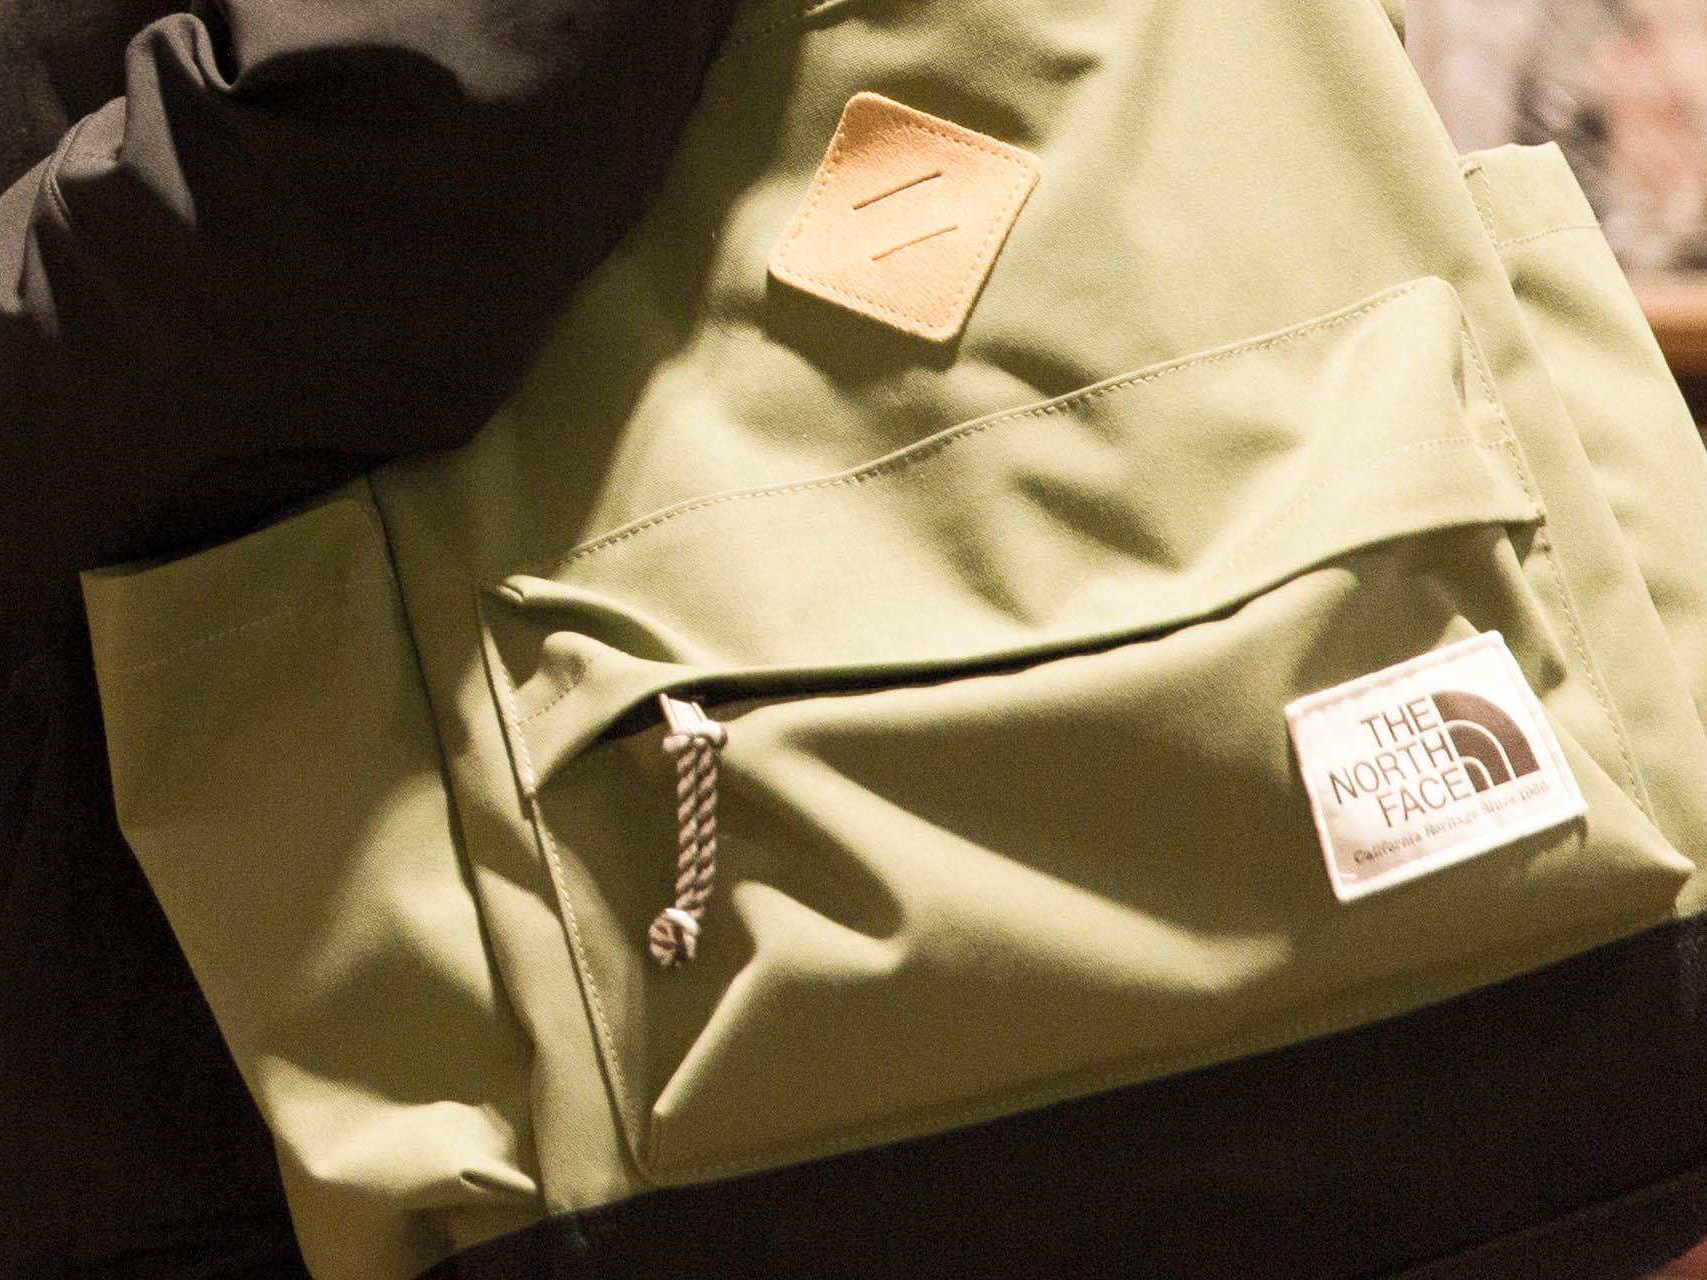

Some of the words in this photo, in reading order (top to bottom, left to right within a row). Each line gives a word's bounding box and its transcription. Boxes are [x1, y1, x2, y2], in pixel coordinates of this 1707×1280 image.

[1359, 693, 1439, 748] THE
[1327, 730, 1456, 806] NORTH
[1377, 766, 1473, 828] FACE
[1352, 831, 1424, 865] California
[1424, 810, 1478, 839] Heritage
